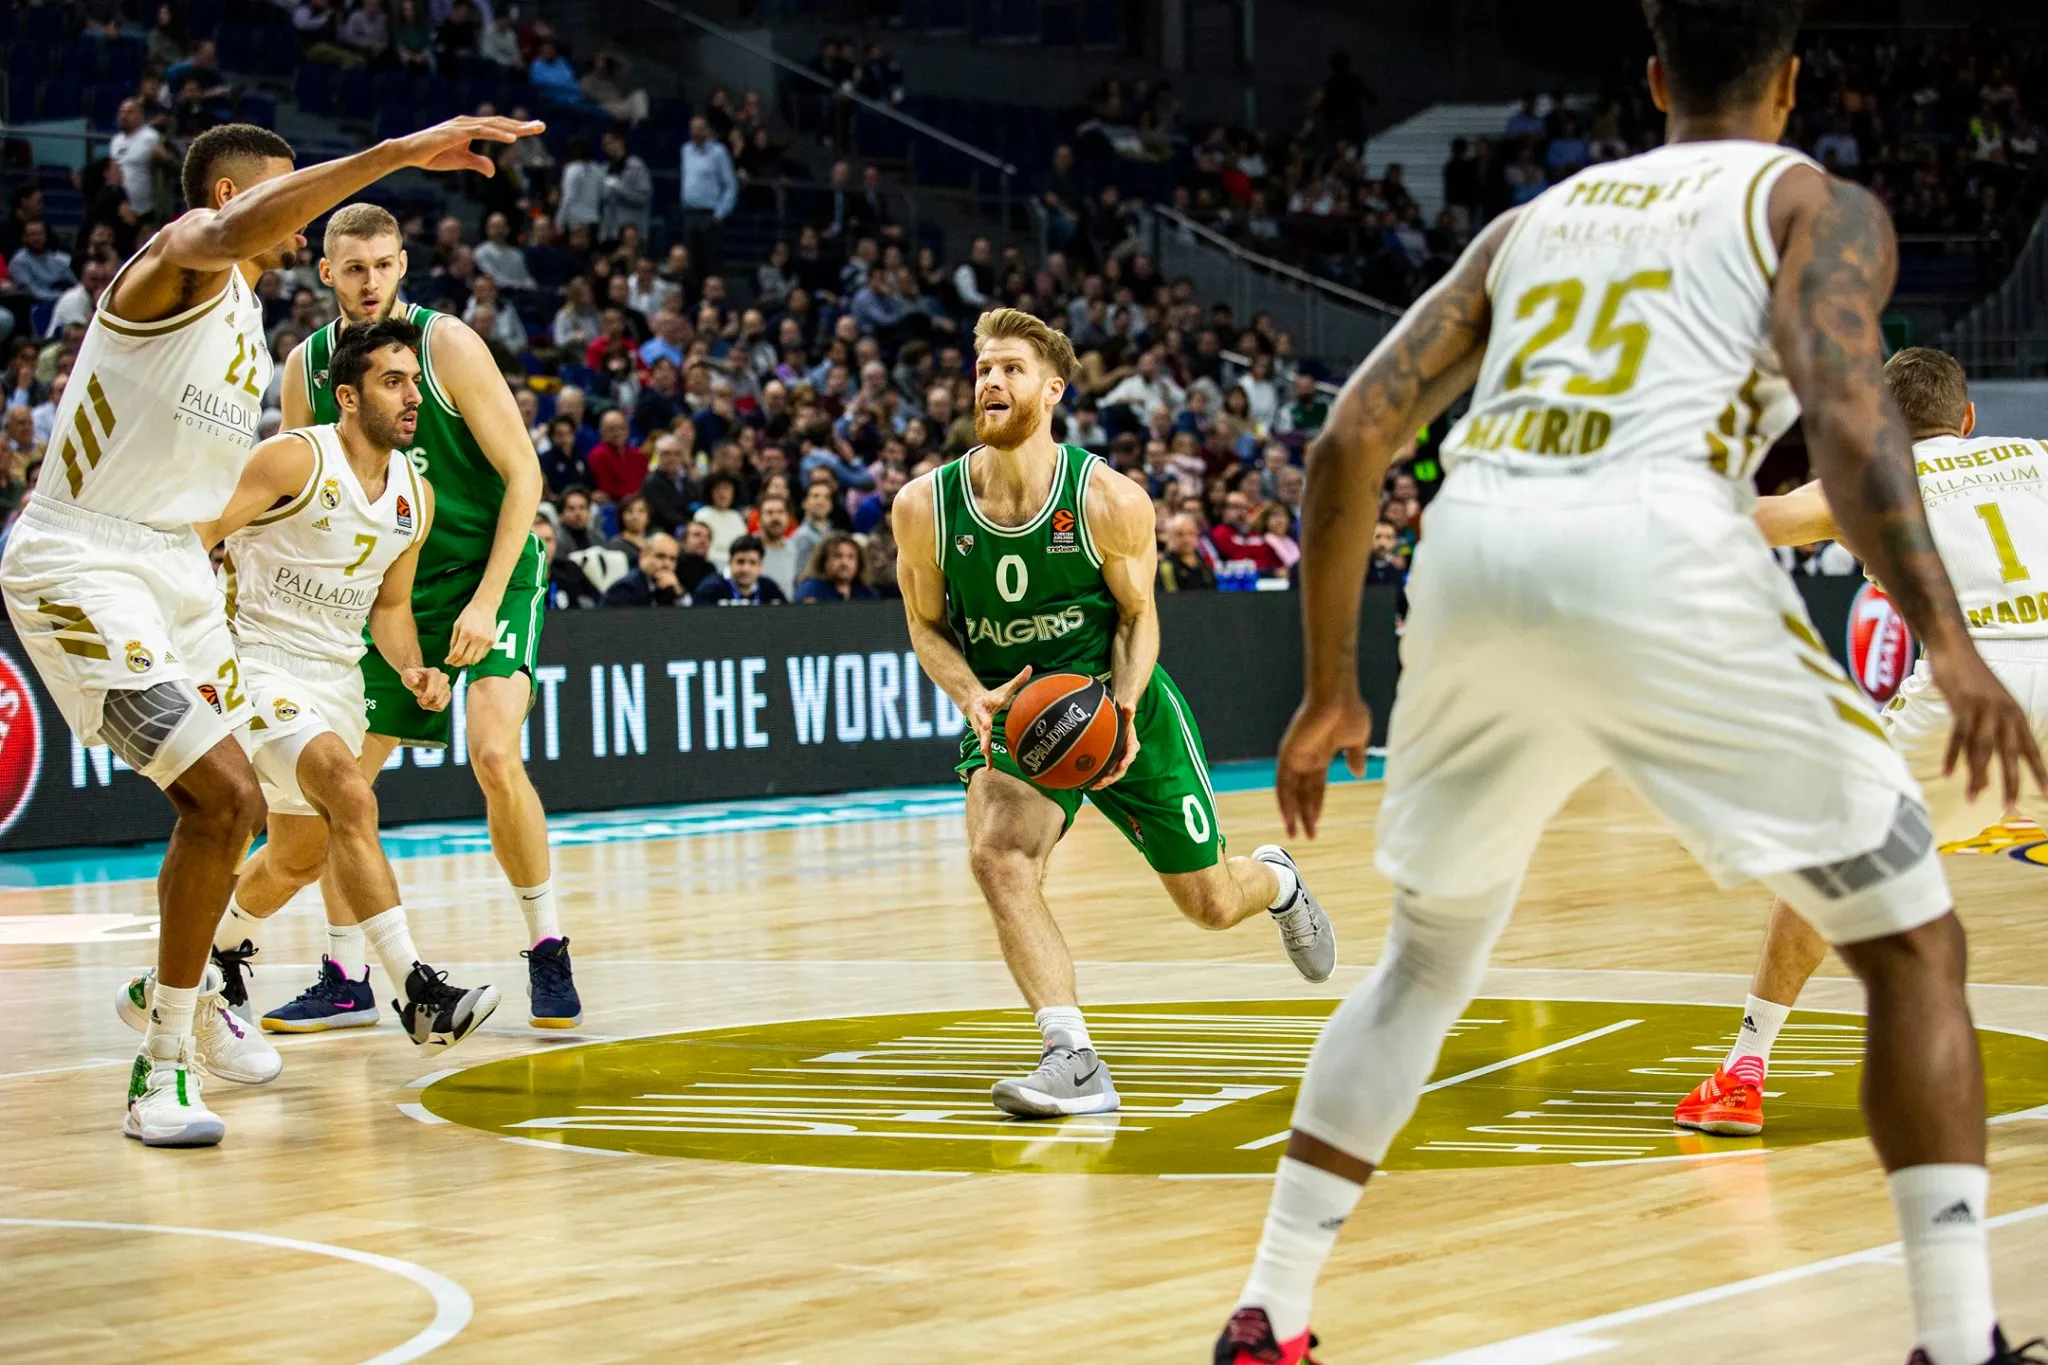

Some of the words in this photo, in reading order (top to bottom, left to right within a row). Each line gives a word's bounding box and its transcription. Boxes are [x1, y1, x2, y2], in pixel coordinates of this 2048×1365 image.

[1505, 268, 1673, 396] 25
[181, 383, 260, 431] PALLADIU
[173, 412, 220, 437] HOTEL
[228, 432, 253, 450] GRO
[1917, 443, 2034, 477] AUSEUR
[1922, 464, 2040, 498] ALLADIUM
[1929, 490, 1971, 508] OTEL
[343, 533, 378, 577] 7
[1973, 502, 2031, 584] 1
[995, 554, 1028, 603] 0
[269, 589, 322, 615] HOTEL
[591, 663, 648, 757] IN
[667, 657, 770, 753] THE
[787, 651, 968, 745] WORLD
[1182, 793, 1211, 845] 0
